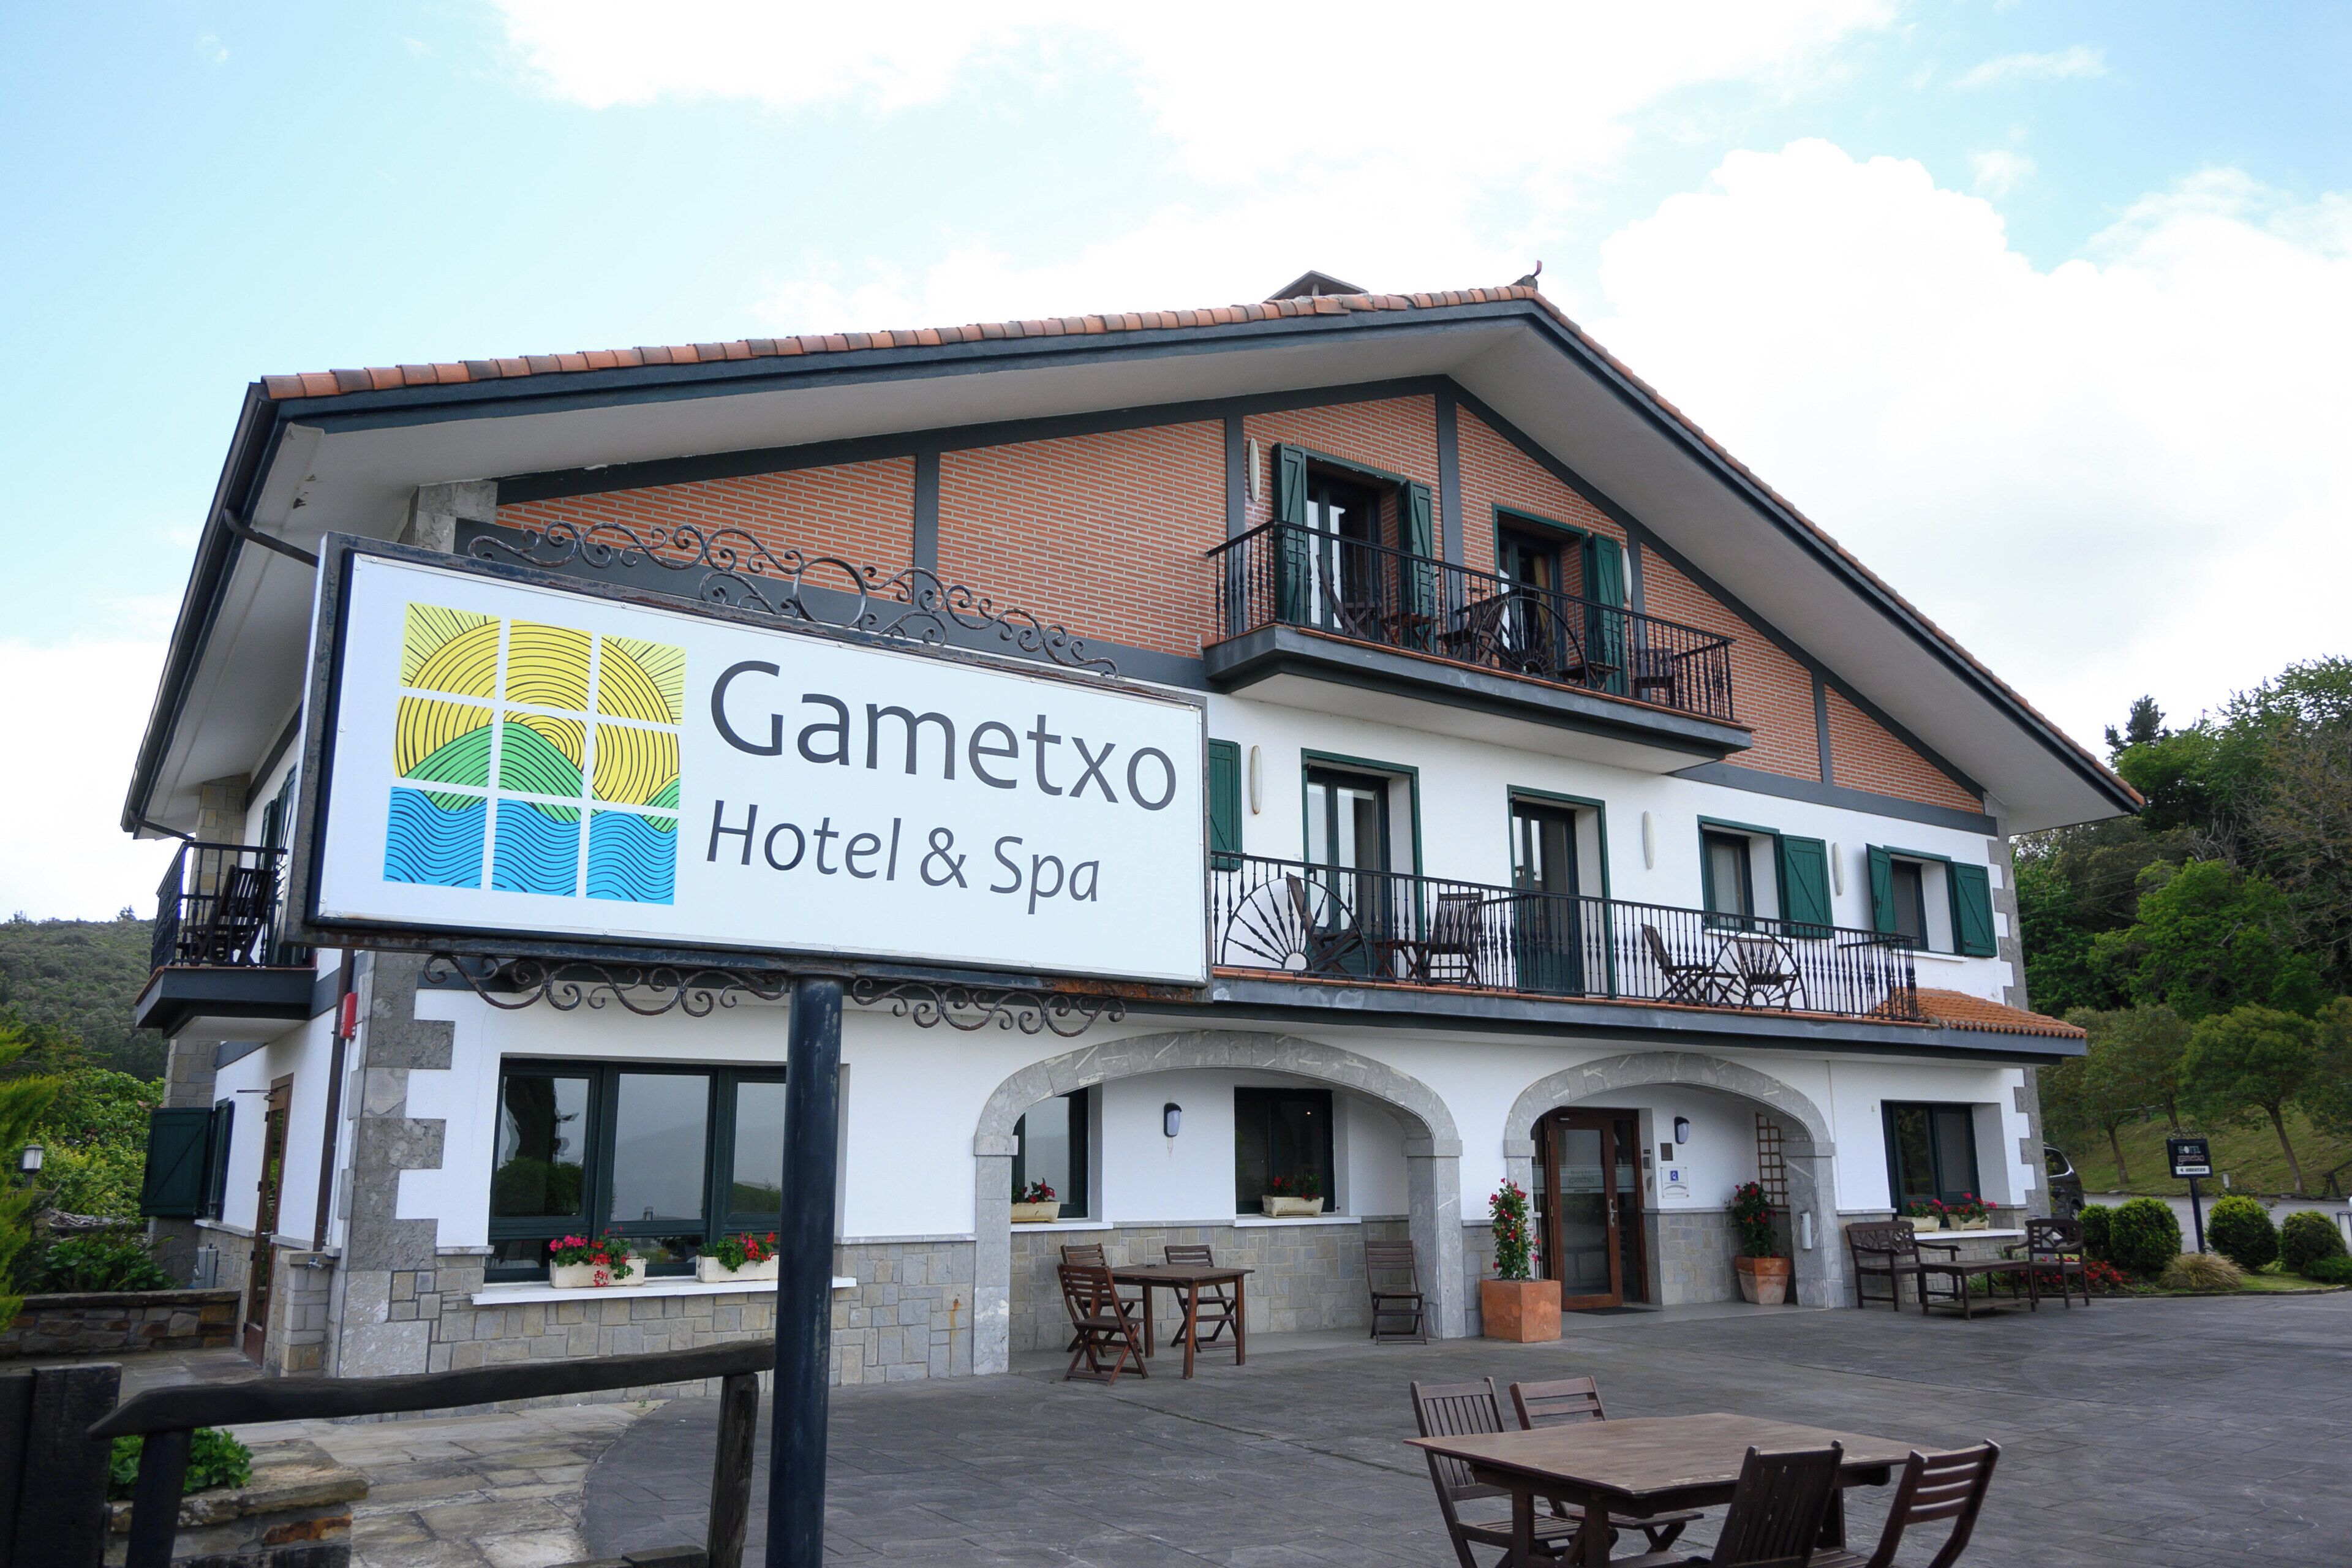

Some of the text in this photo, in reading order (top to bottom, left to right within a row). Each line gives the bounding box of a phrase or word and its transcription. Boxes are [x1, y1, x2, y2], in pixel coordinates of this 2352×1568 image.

[710, 660, 1176, 811] Gametxo
[706, 799, 1099, 915] Hotel & Spa
